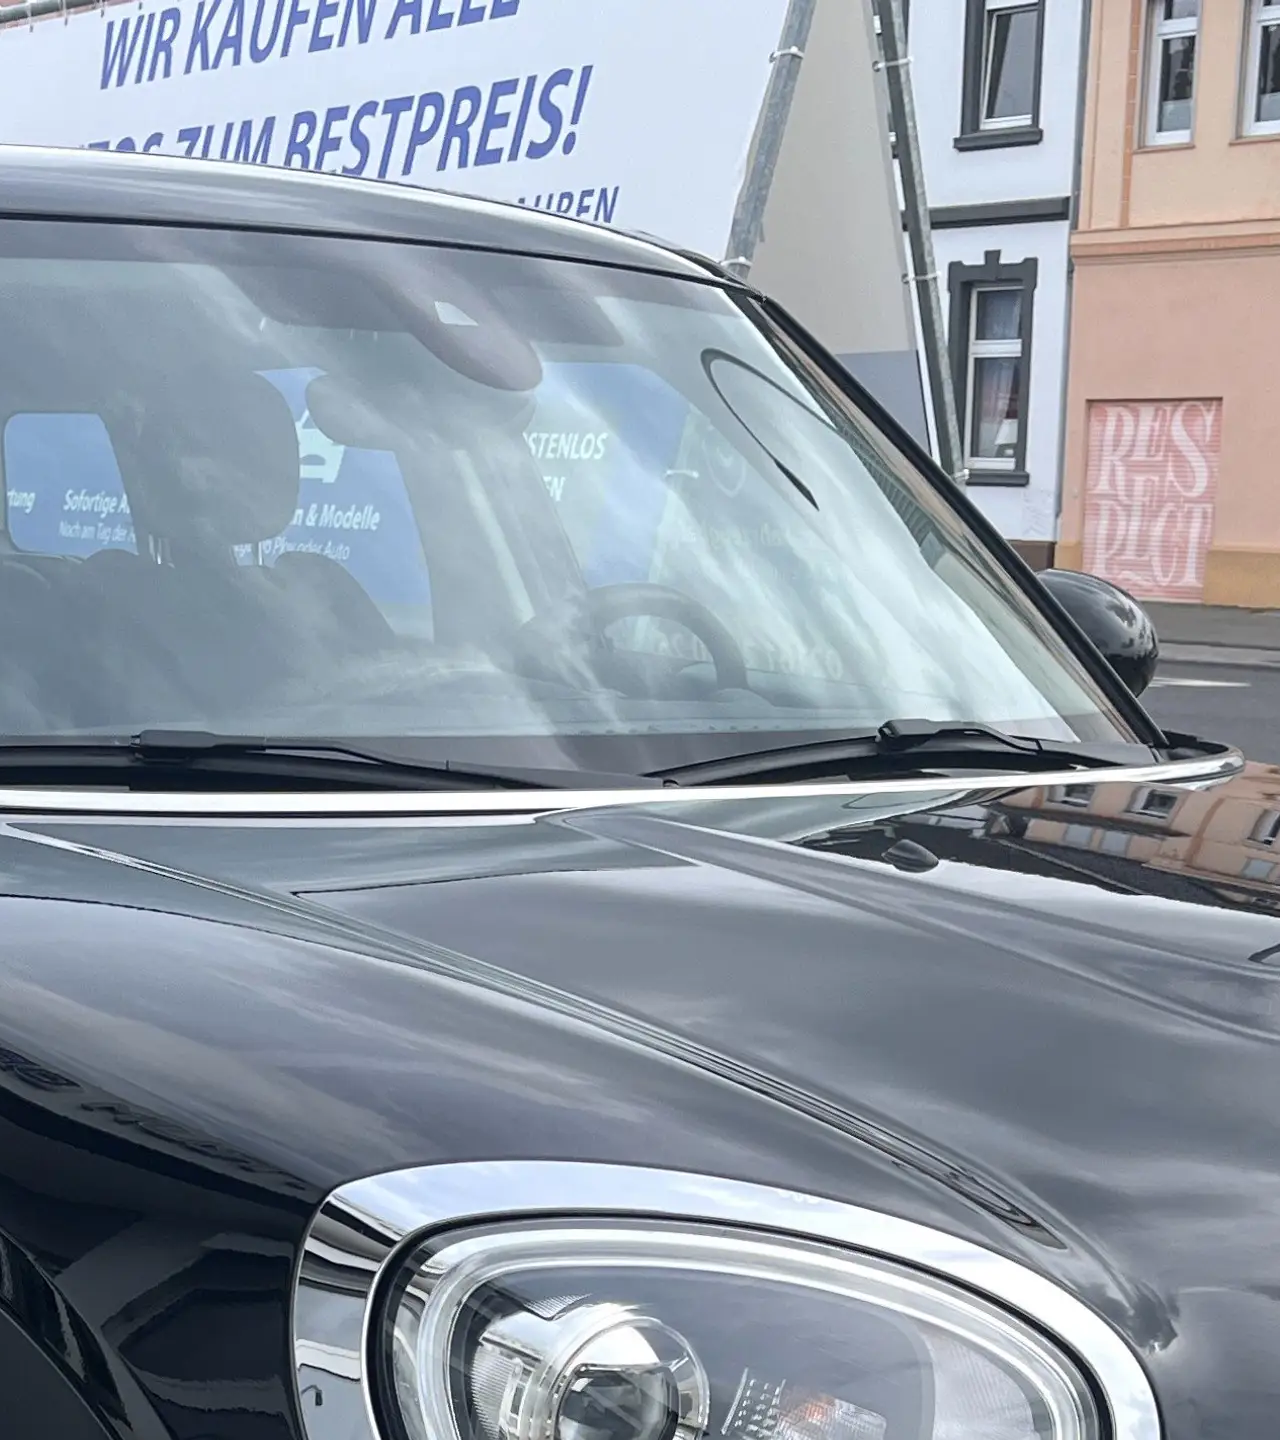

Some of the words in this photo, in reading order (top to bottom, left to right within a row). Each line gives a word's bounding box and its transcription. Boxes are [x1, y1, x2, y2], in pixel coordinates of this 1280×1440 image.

[100, 7, 181, 90] WIR
[183, 0, 381, 75] KAUFEN
[384, 0, 518, 40] AL
[283, 65, 593, 179] BESTPREIS!
[523, 432, 608, 460] STENLOS
[63, 488, 118, 518] Sofortige
[320, 503, 381, 531] Modelle
